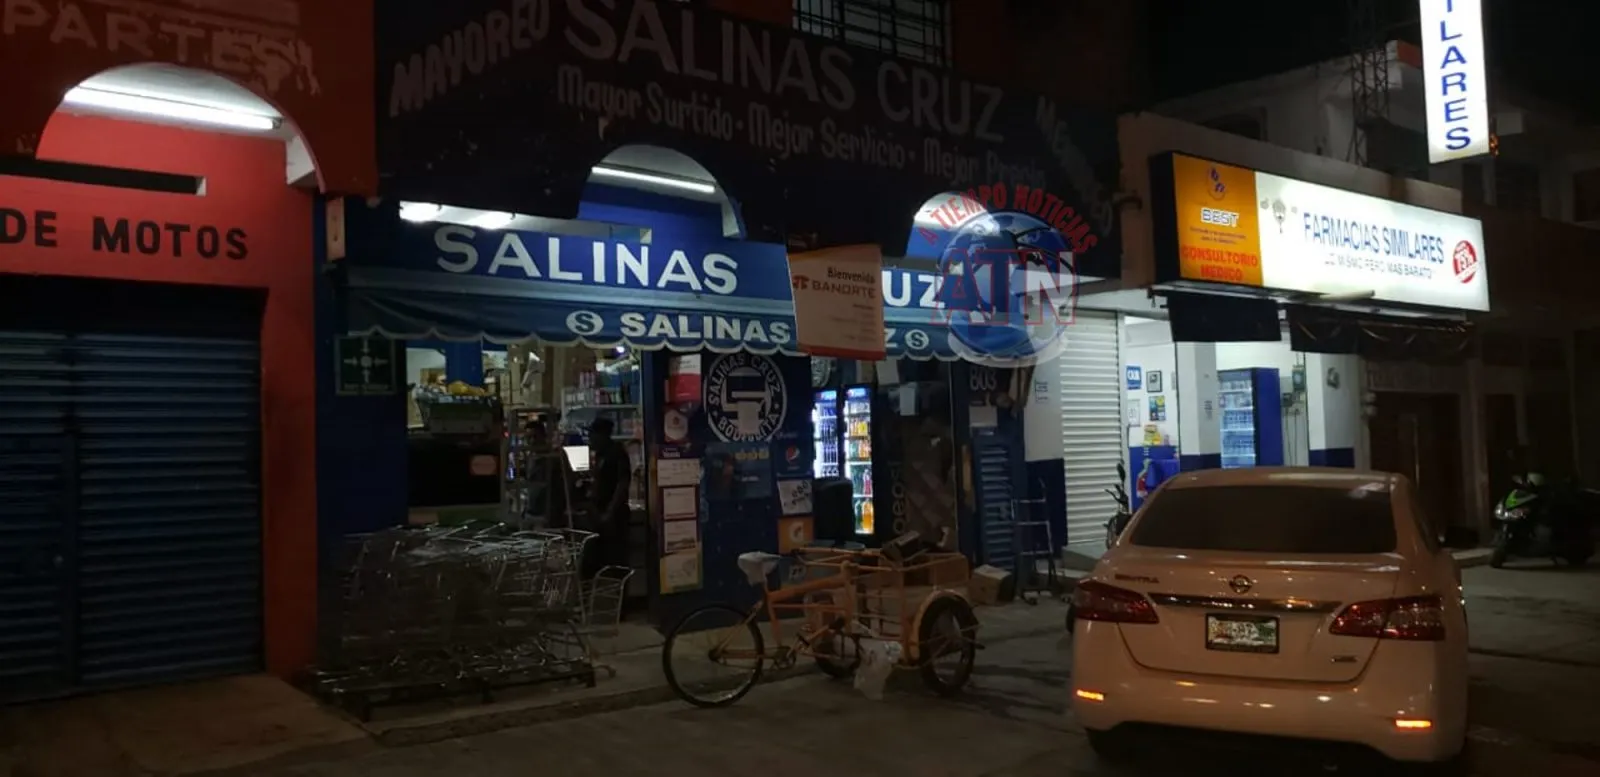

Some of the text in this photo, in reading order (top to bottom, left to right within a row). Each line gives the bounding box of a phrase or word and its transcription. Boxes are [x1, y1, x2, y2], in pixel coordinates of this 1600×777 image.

[389, 0, 549, 118] MAYOREO
[563, 0, 1004, 143] SALINAS CRUZ
[557, 64, 642, 119] Mayor
[646, 81, 733, 141] Surtido
[748, 101, 814, 160] Mejor
[820, 116, 906, 169] Servicio
[924, 136, 979, 186] Mejor
[0, 208, 248, 260] DE MOTOS
[1201, 208, 1239, 227] BEST
[1304, 212, 1445, 264] FARMACIAS SIMILARES
[432, 224, 945, 309] SALINAS UZ
[1181, 246, 1258, 267] CONSULTORIO
[812, 280, 877, 299] BANORTE
[619, 311, 792, 345] SALINAS
[709, 352, 746, 406] SALINAS
[751, 356, 781, 398] CRUZ
[969, 366, 997, 391] 803
